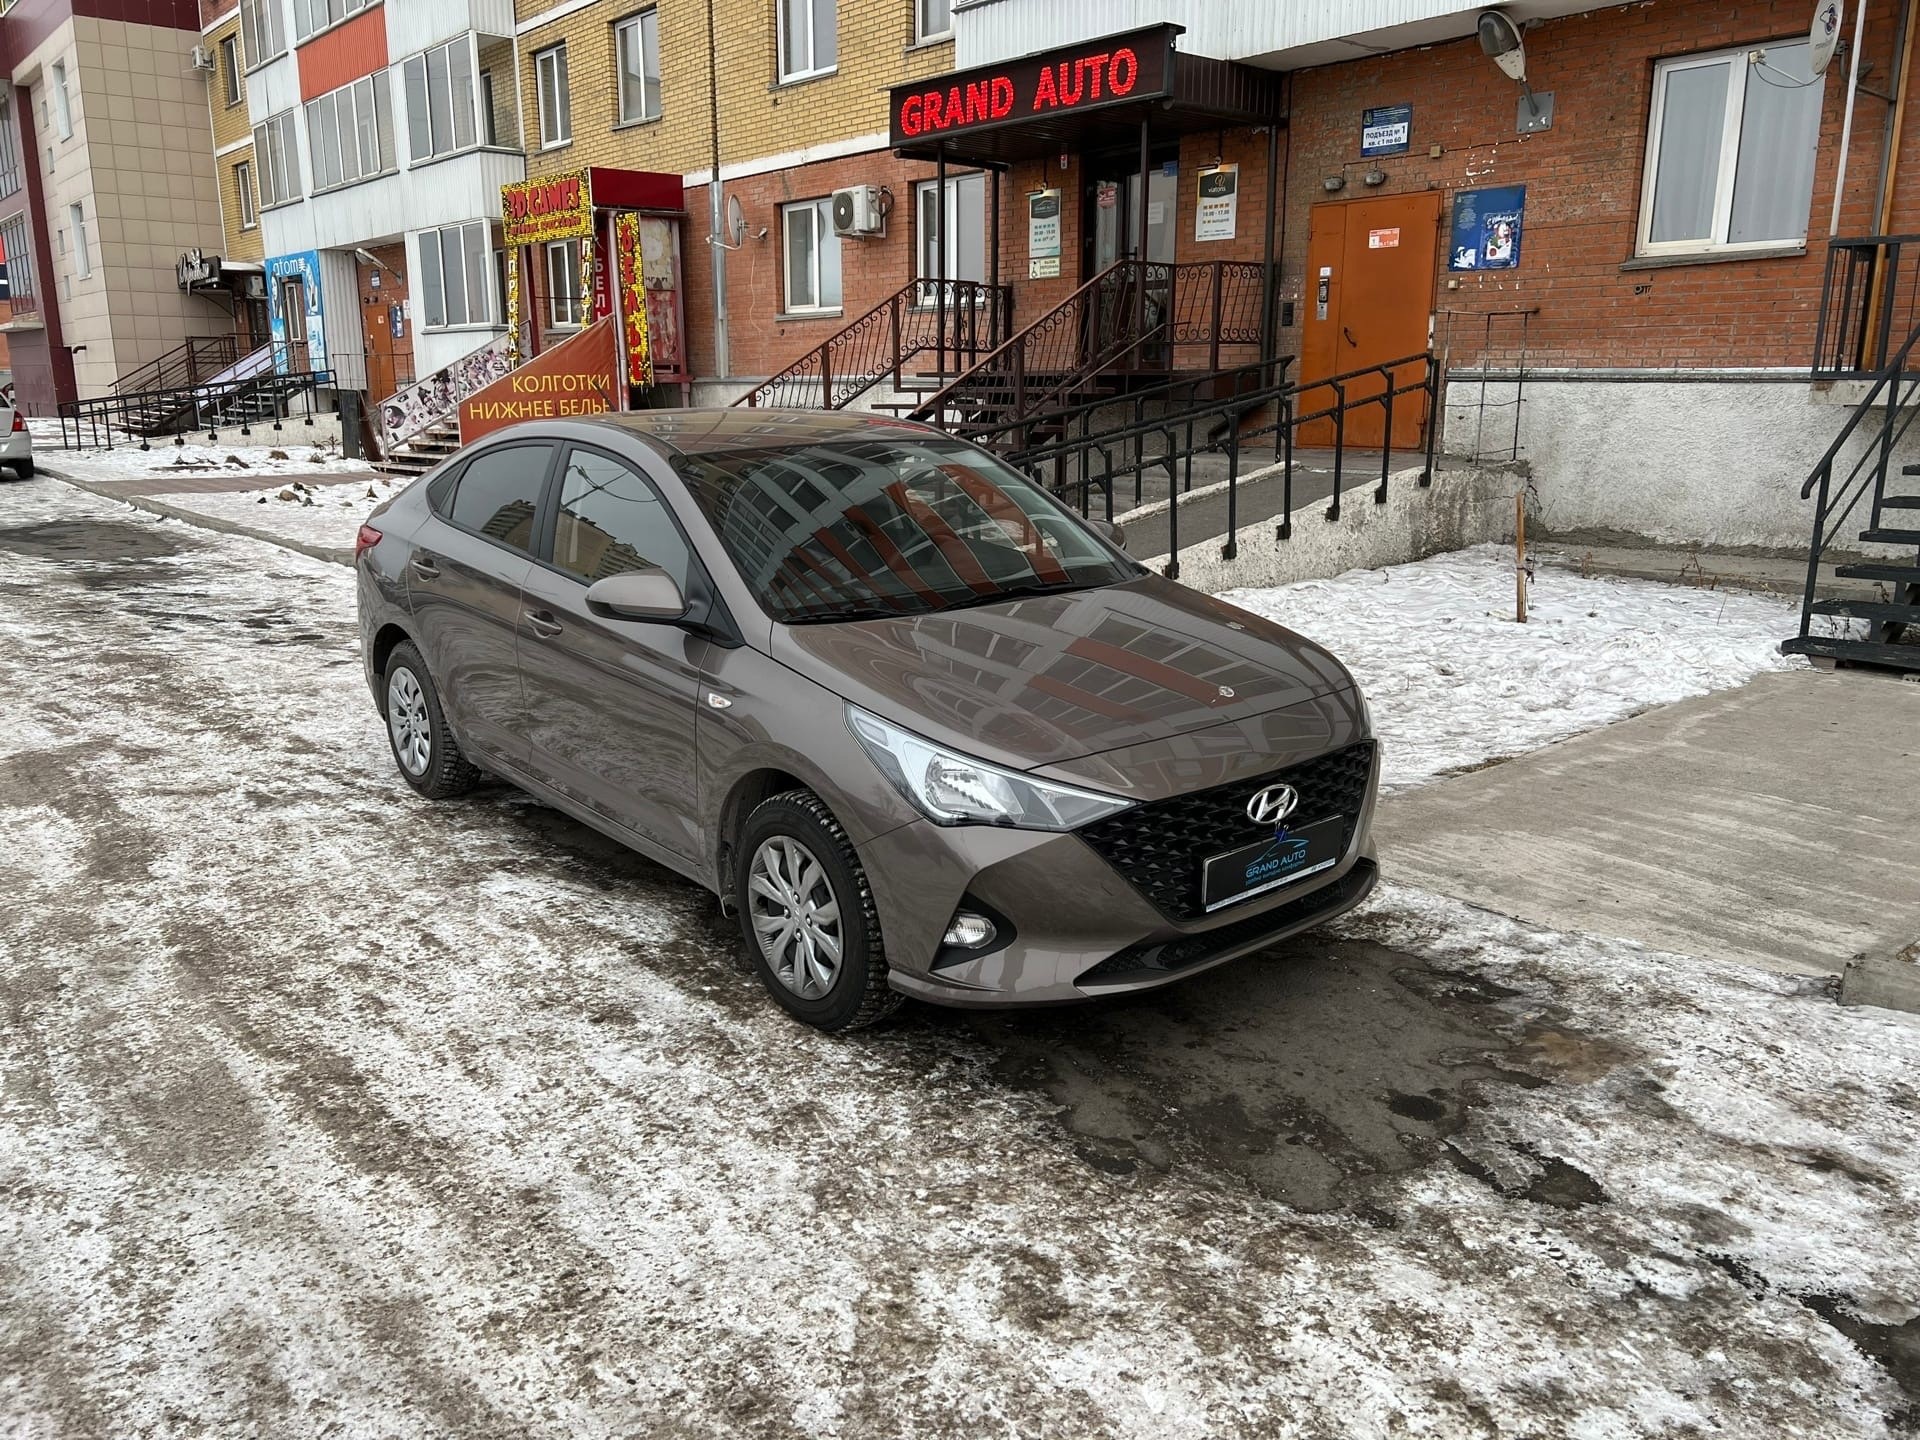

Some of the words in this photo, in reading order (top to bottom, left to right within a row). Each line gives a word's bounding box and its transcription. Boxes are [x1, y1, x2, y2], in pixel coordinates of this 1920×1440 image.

[900, 76, 1015, 137] GRAND
[1033, 47, 1139, 111] AUTO
[1366, 129, 1393, 139] ПОДЪЕЗД
[1402, 125, 1406, 134] 1
[507, 189, 527, 219] 3D
[528, 176, 580, 216] GAMES
[512, 374, 610, 393] КОЛГОТКИ
[469, 399, 554, 420] НИЖНЕЕ
[1245, 859, 1279, 879] GRAND
[1280, 849, 1306, 866] AUTO
